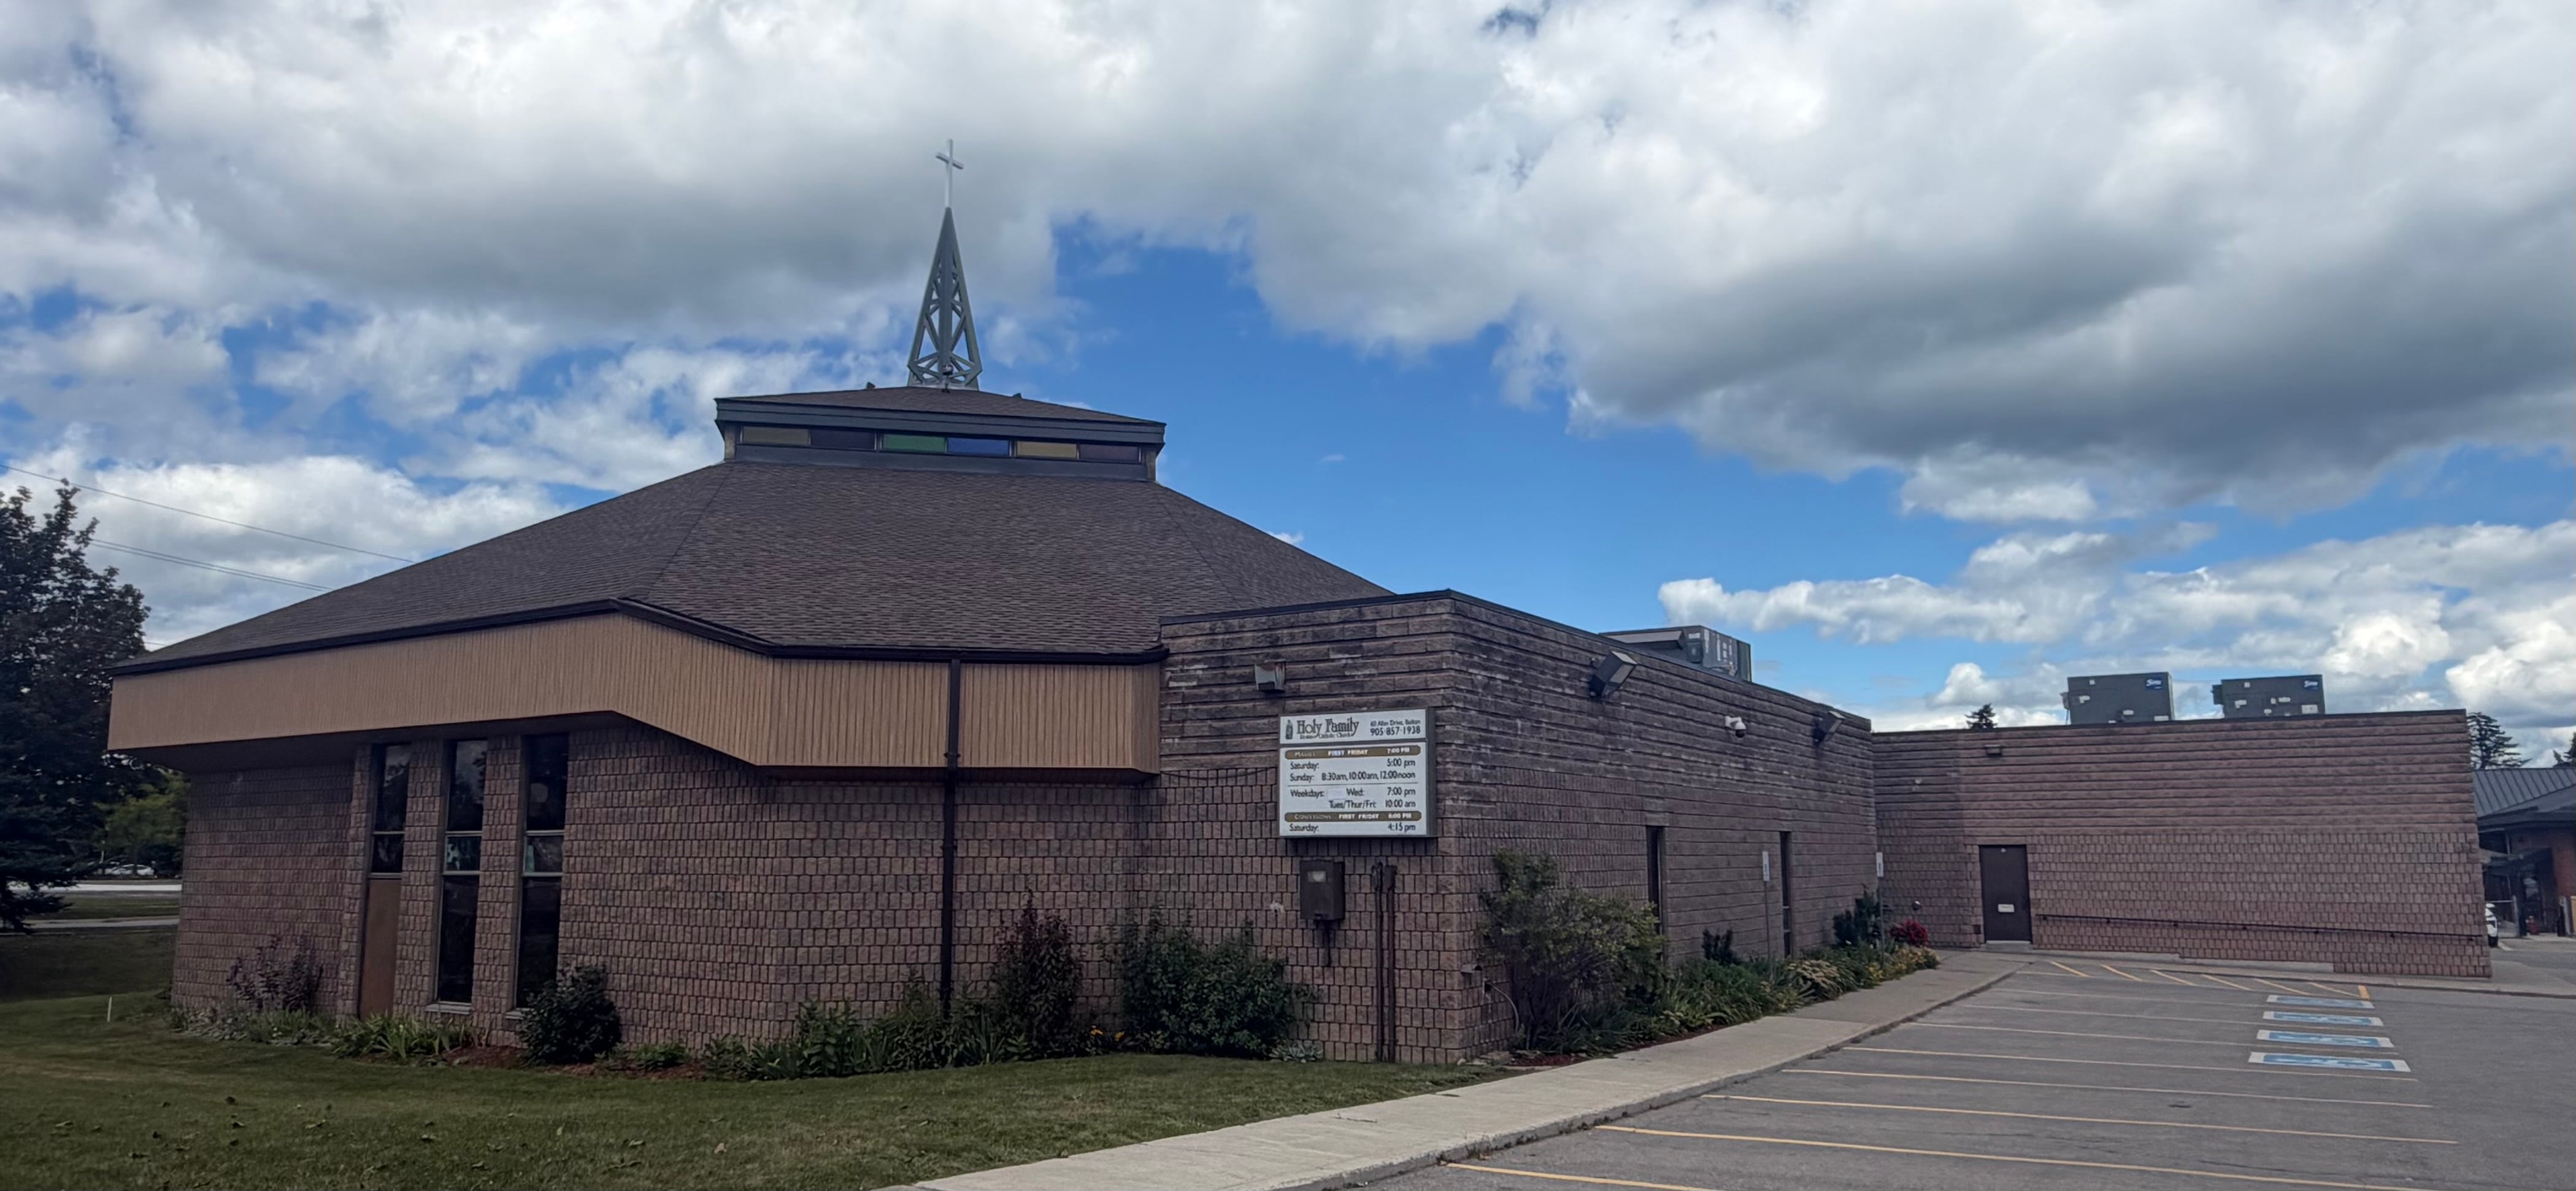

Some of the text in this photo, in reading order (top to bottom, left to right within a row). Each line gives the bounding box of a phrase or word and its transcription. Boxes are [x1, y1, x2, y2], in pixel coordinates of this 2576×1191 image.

[1296, 717, 1359, 736] Holy Family
[1386, 758, 1402, 767] 5:00
[1404, 760, 1416, 768] pm
[1386, 787, 1402, 796] 7:00
[1404, 788, 1416, 798] pm
[1385, 799, 1403, 807] 10:00
[1387, 822, 1403, 831] 4:15
[1404, 824, 1416, 833] pm
